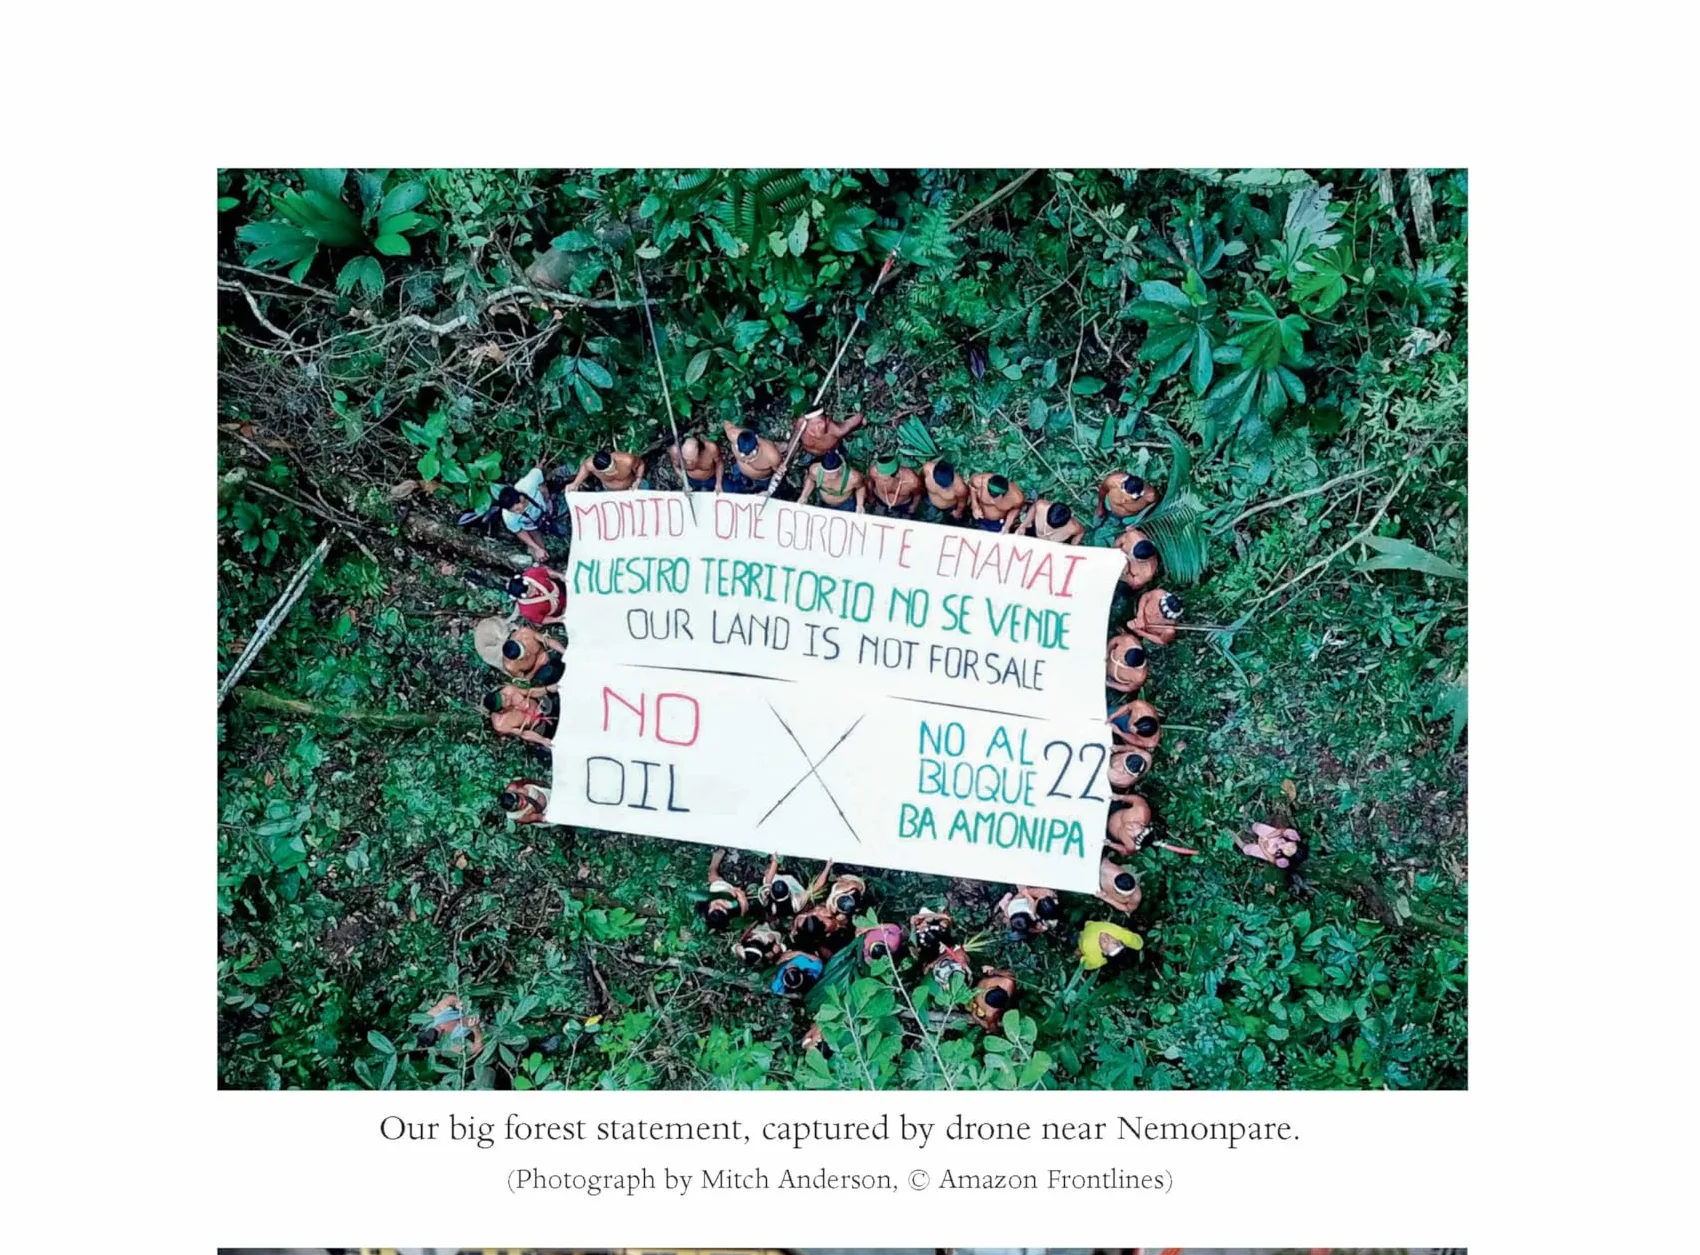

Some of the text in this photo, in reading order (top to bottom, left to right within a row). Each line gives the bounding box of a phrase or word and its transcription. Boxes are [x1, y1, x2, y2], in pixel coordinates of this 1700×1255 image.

[715, 499, 765, 540] OME
[937, 535, 1087, 597] ENAMAI
[574, 557, 1071, 650] NUESTRO TERRITORIO NO SE VENDE
[627, 608, 693, 640] OUR
[712, 609, 789, 650] LAND
[802, 623, 840, 660] IS
[858, 633, 919, 669] NOT
[603, 686, 700, 746] NO
[919, 720, 1034, 765] NO AL
[586, 756, 690, 812] OIL
[918, 740, 1106, 807] BLOQUE 22
[899, 803, 1085, 858] BA AMONIPA
